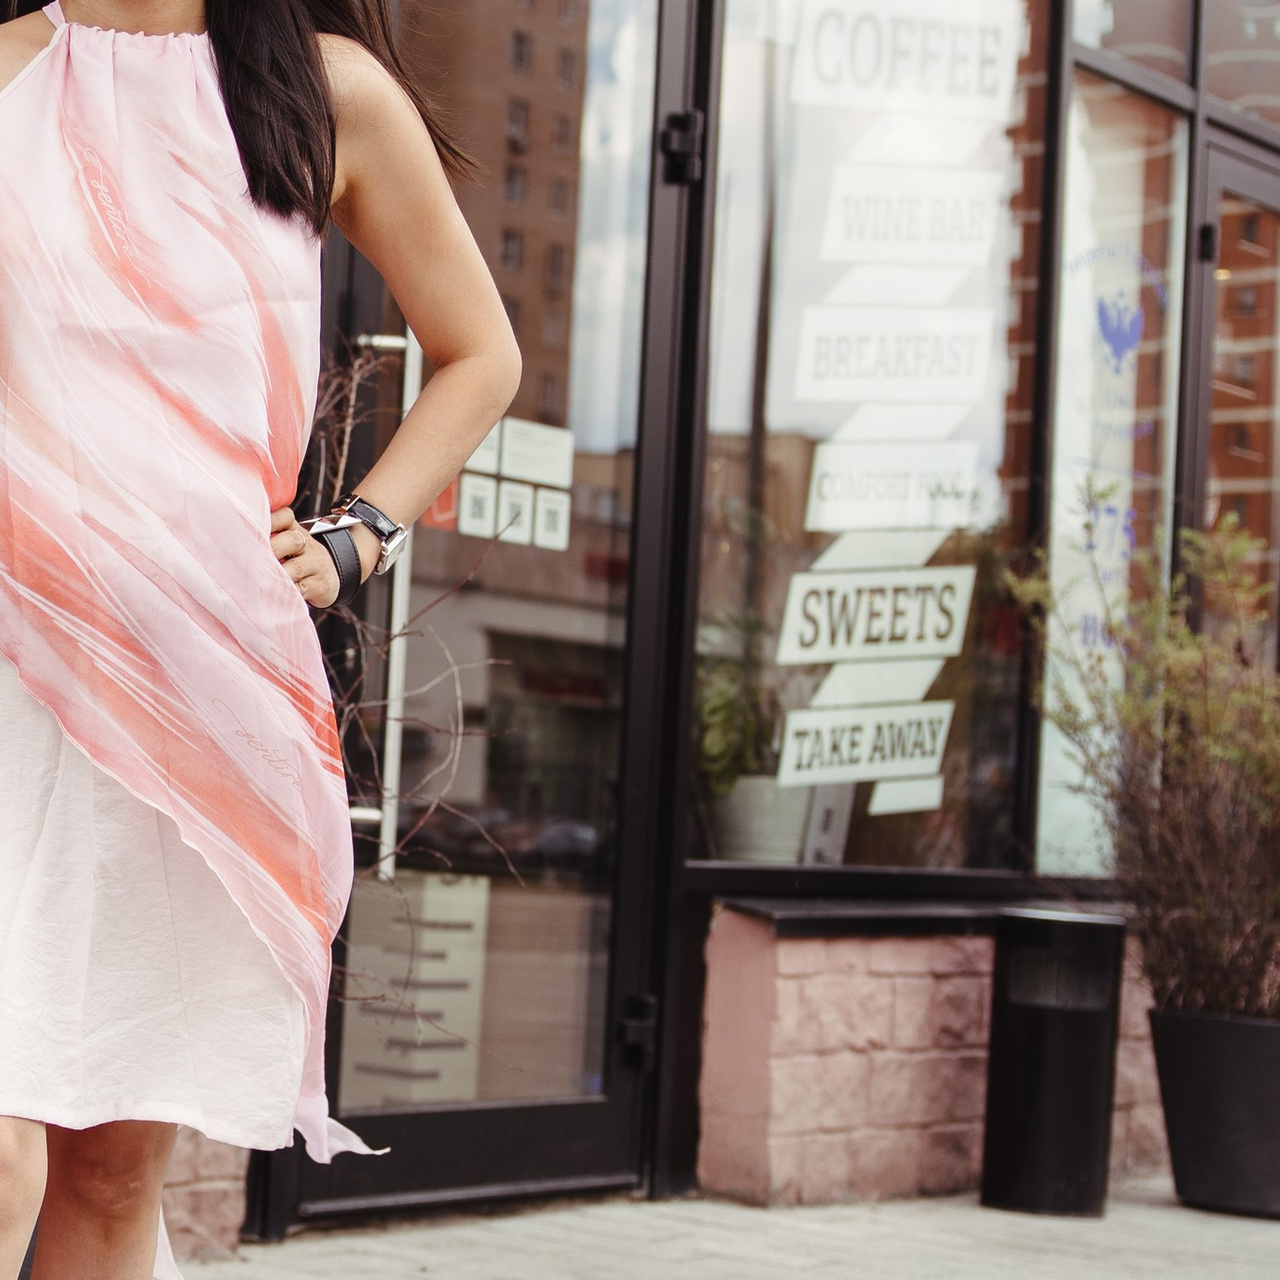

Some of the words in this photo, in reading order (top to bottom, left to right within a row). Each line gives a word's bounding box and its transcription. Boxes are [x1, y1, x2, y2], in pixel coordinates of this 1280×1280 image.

[815, 8, 1003, 98] COFFEE
[841, 194, 922, 243] WINE
[928, 196, 987, 243] BAR
[812, 333, 980, 381] BREAKFAST
[798, 582, 958, 649] SWEETS
[793, 723, 864, 772] TAKE
[867, 716, 944, 764] AWAY
